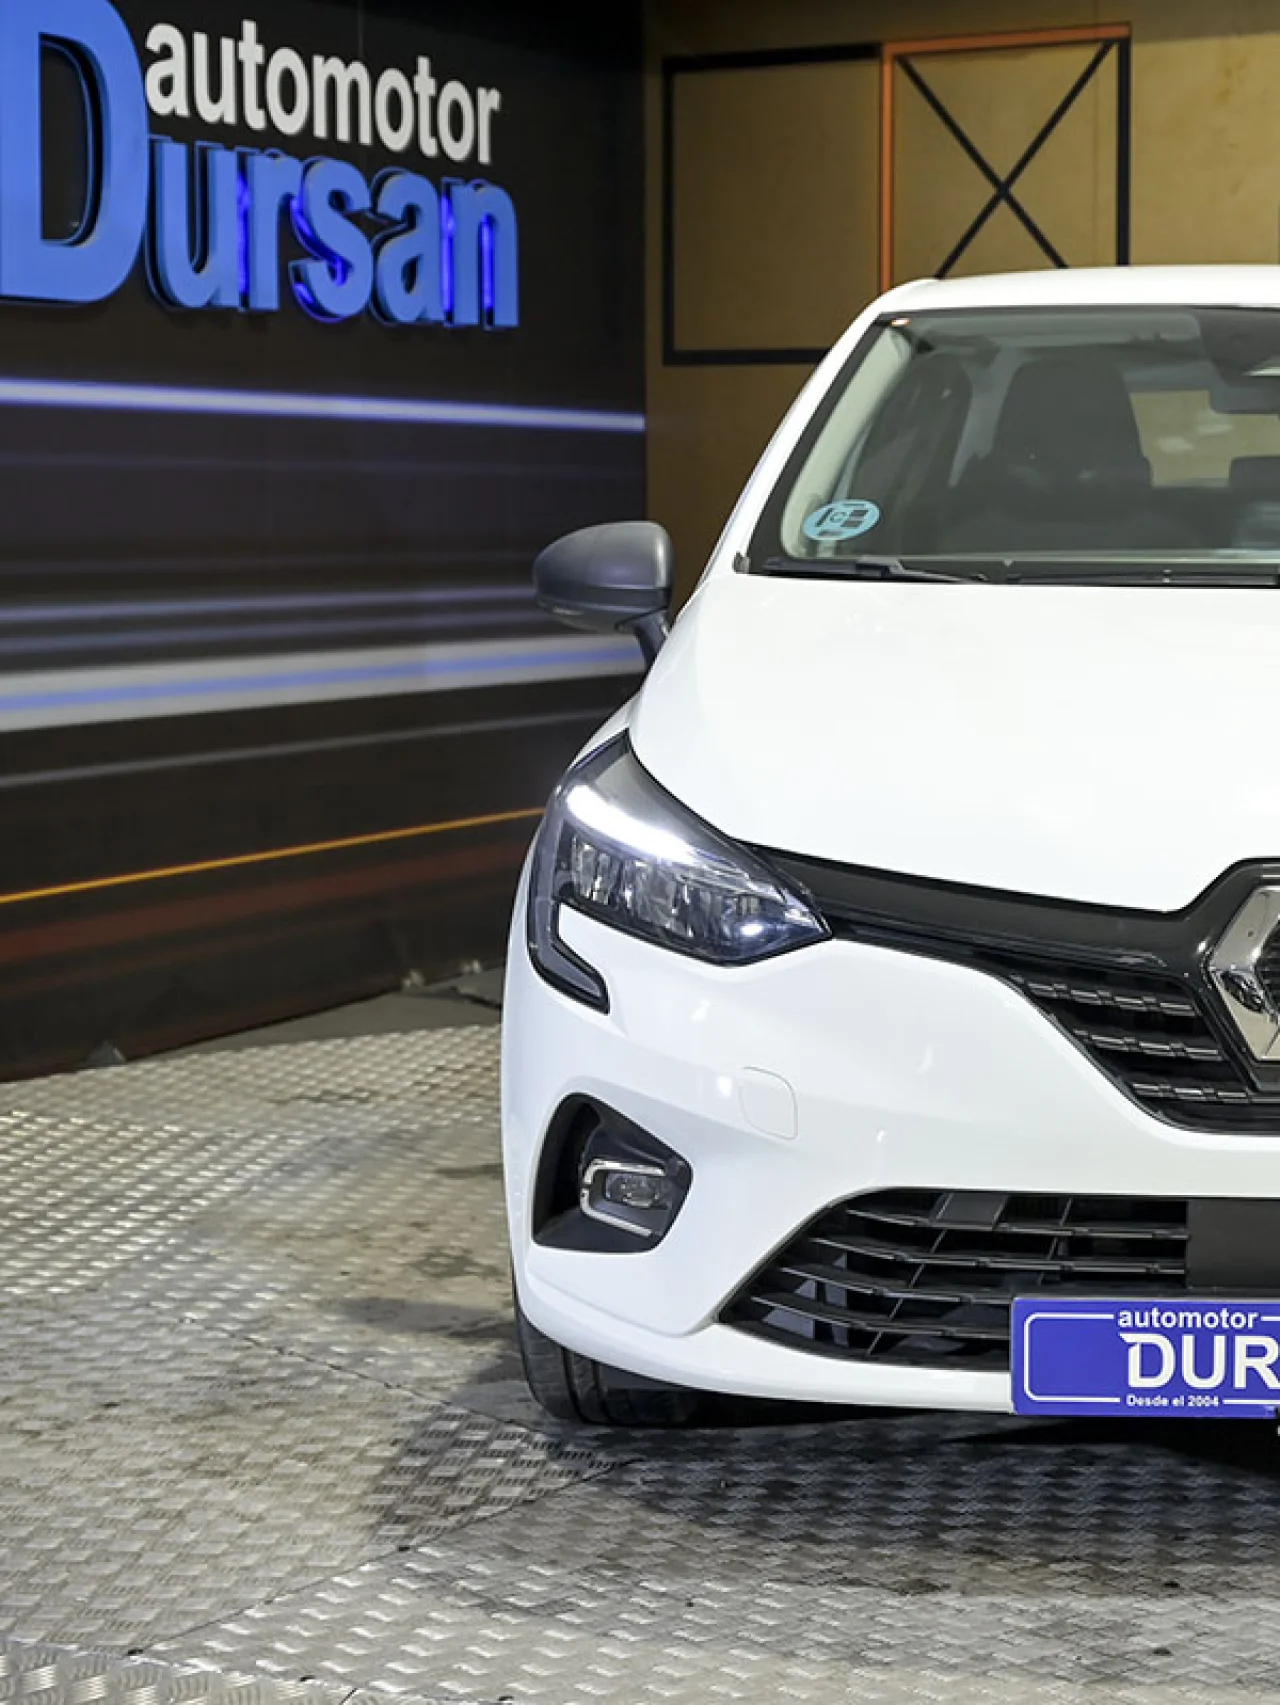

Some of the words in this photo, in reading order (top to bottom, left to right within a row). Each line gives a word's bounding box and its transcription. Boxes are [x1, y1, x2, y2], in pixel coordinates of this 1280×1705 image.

[145, 19, 501, 164] automotor
[0, 0, 519, 330] Dursan
[1118, 1307, 1259, 1329] automotor
